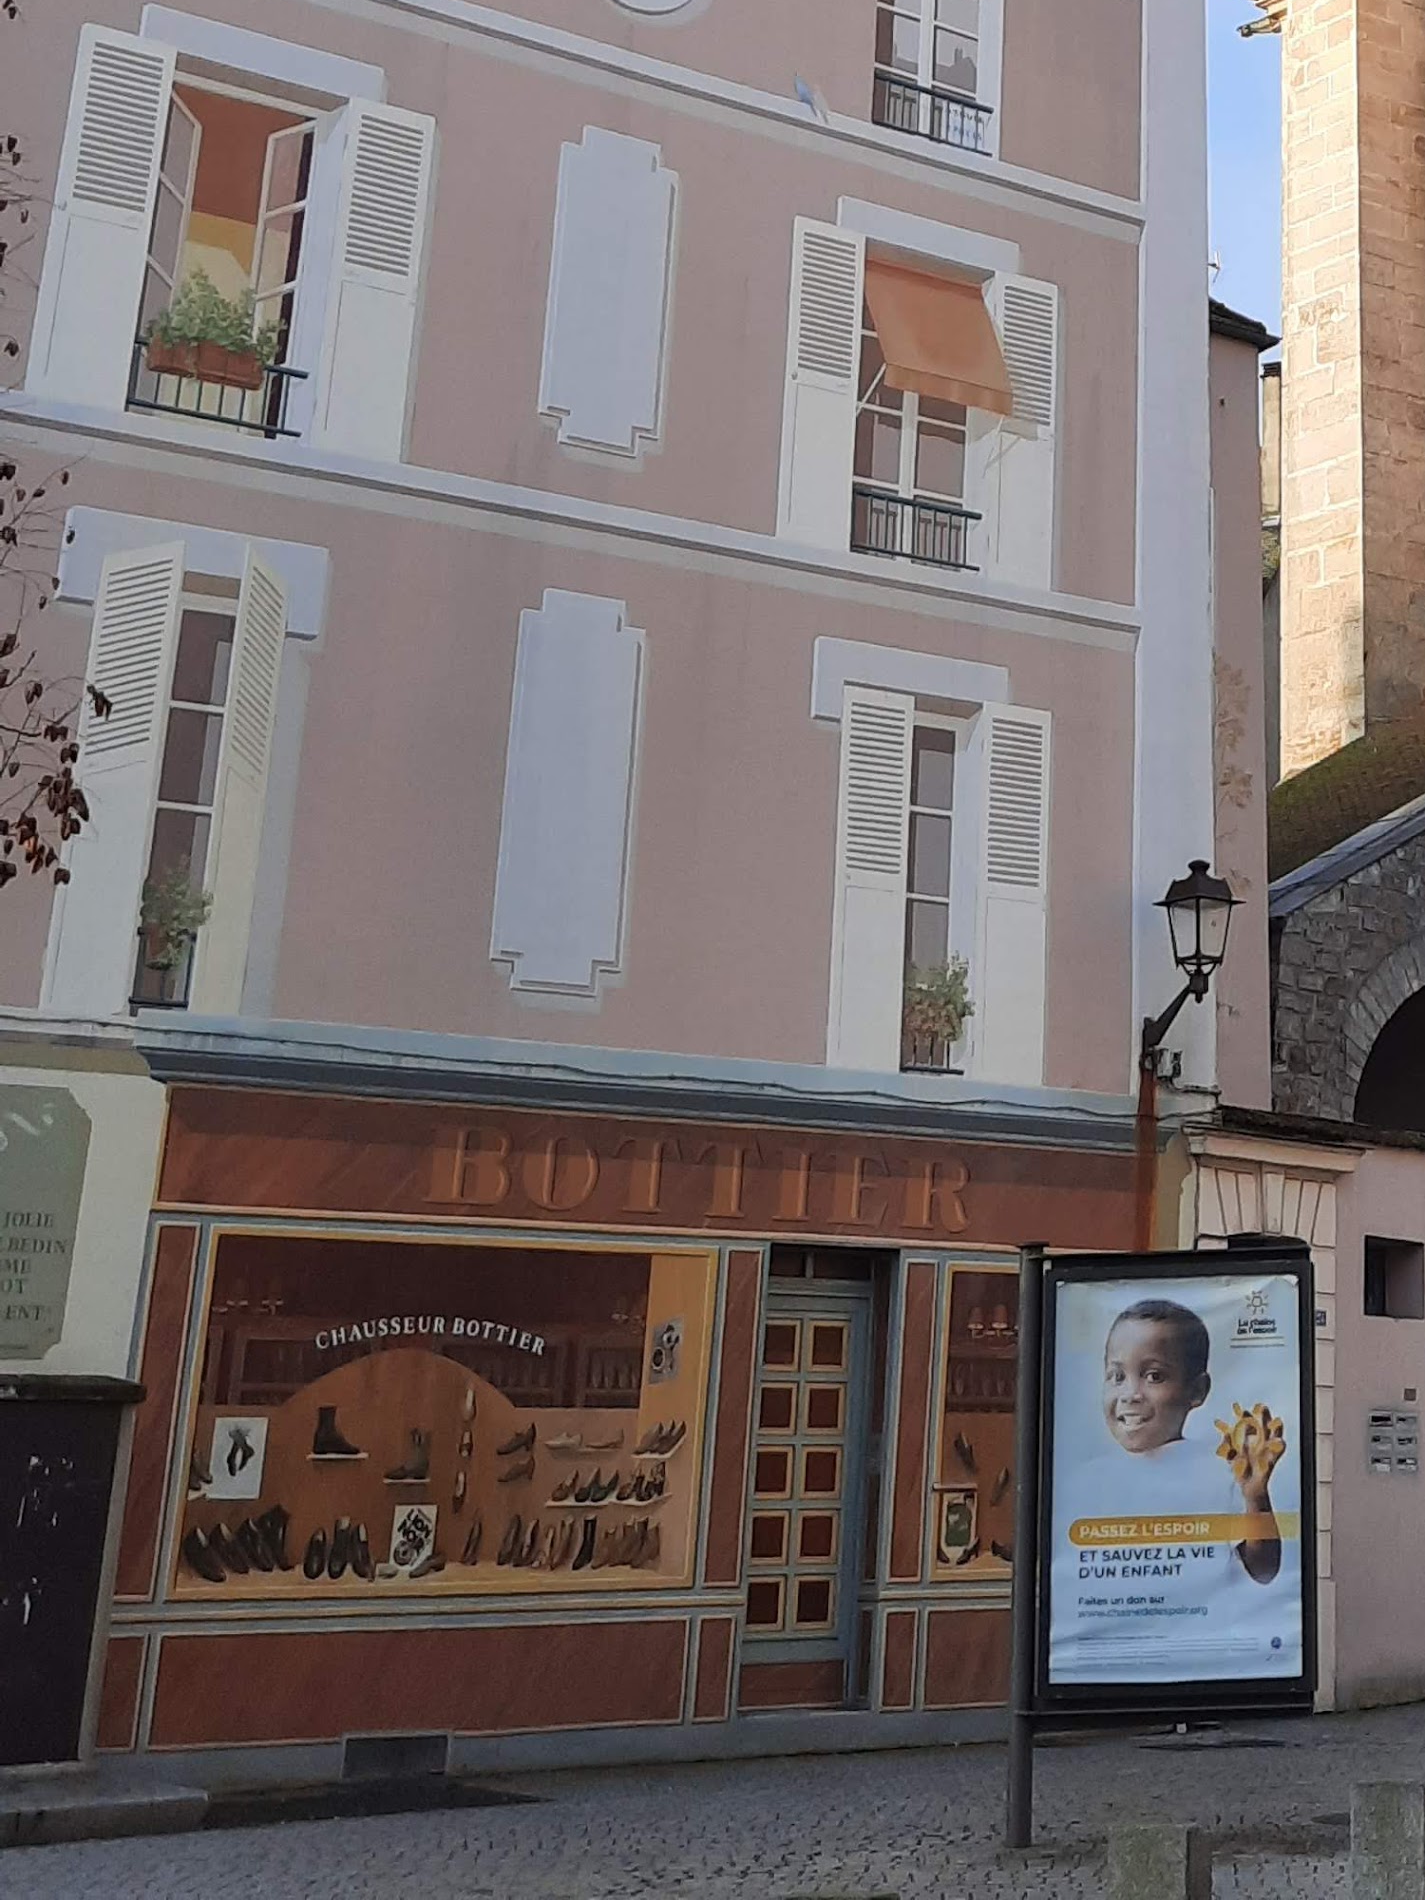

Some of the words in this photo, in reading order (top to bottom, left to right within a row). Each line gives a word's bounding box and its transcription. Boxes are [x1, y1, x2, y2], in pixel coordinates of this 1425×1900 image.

[421, 1124, 976, 1235] BOTTIER
[314, 1316, 446, 1350] CHAUSSEUR
[452, 1316, 546, 1356] BOTTIER
[1079, 1523, 1139, 1539] PASSEZ
[1142, 1521, 1211, 1537] L'ESPOIR
[1079, 1550, 1098, 1563] ET
[1102, 1548, 1163, 1562] SAUVEZ
[1167, 1547, 1186, 1560] LA
[1190, 1546, 1216, 1559] VIE
[1079, 1566, 1117, 1579] D'UN
[1121, 1564, 1183, 1578] ENFANT
[1110, 1597, 1124, 1605] un
[1126, 1595, 1147, 1605] don
